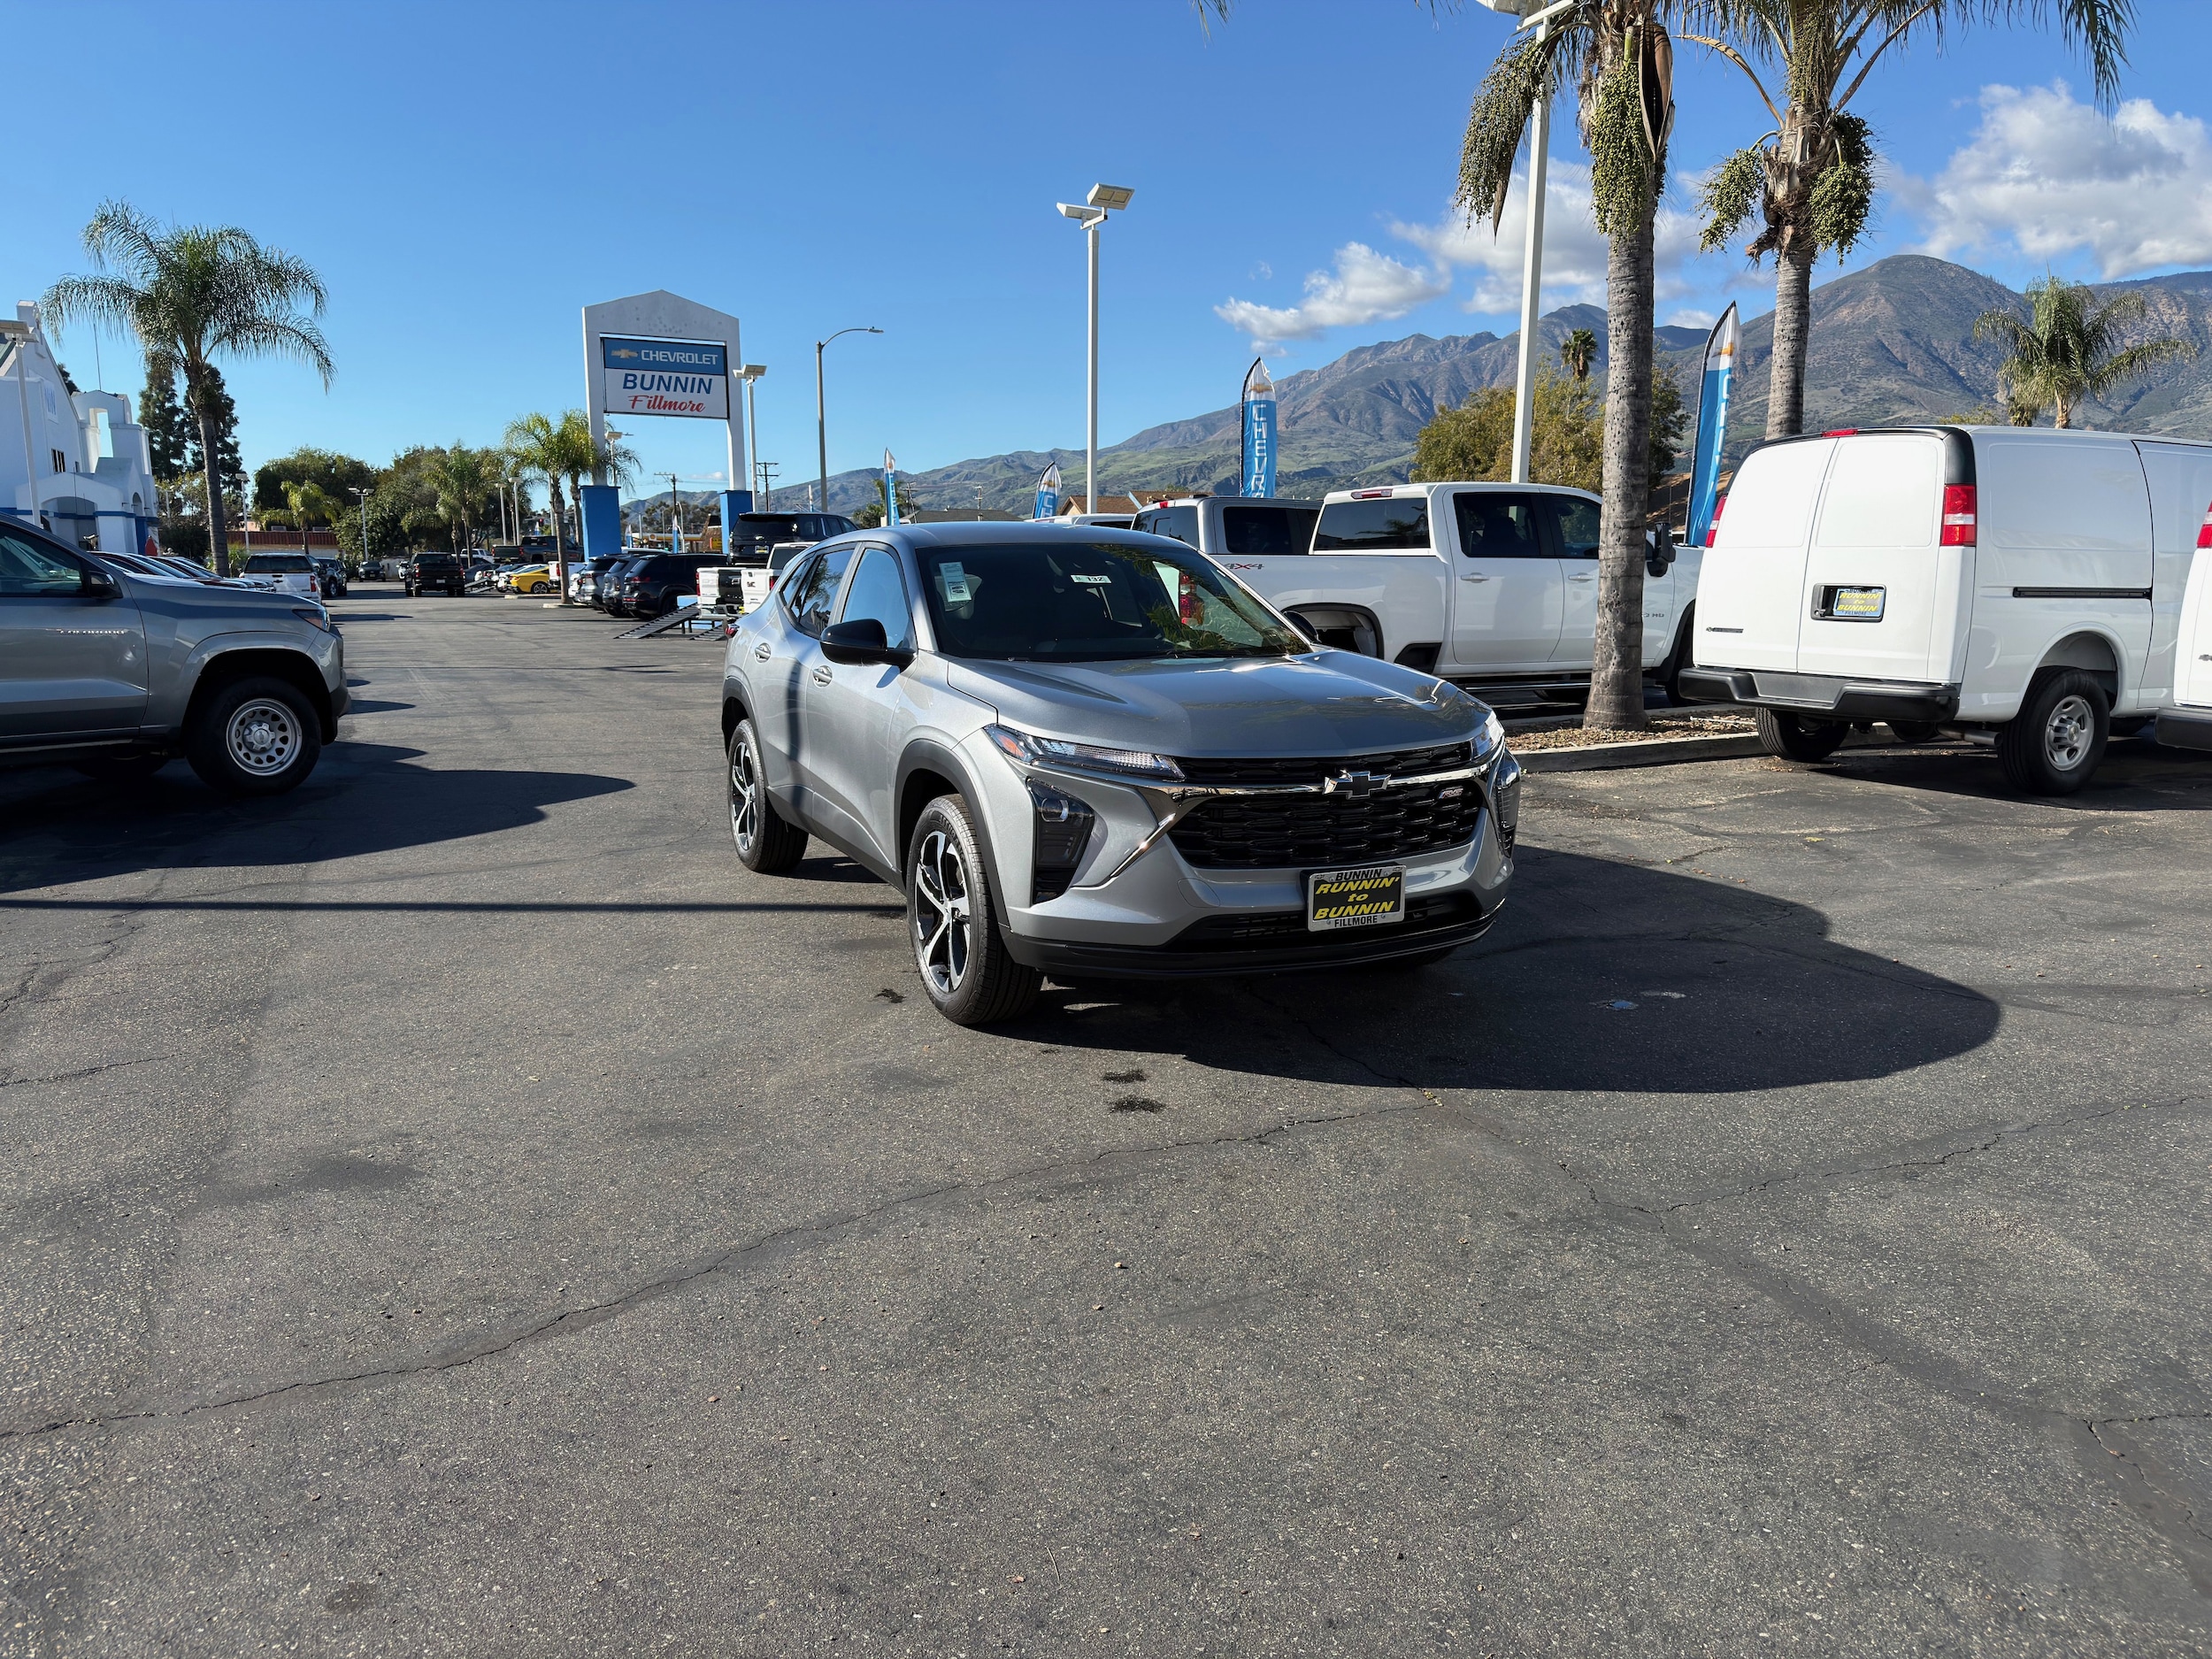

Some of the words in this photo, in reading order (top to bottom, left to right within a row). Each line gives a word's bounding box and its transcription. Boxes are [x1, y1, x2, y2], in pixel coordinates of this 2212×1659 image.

[641, 349, 718, 365] CHEVROLET
[622, 373, 713, 395] BUNNIN
[627, 395, 706, 413] Fillmore
[1335, 868, 1383, 881] BUNNIN
[1315, 876, 1401, 895] RUNNIN'
[1347, 893, 1370, 902] to
[1313, 900, 1395, 920] BUNNIN
[1334, 915, 1379, 928] FILLMORE
